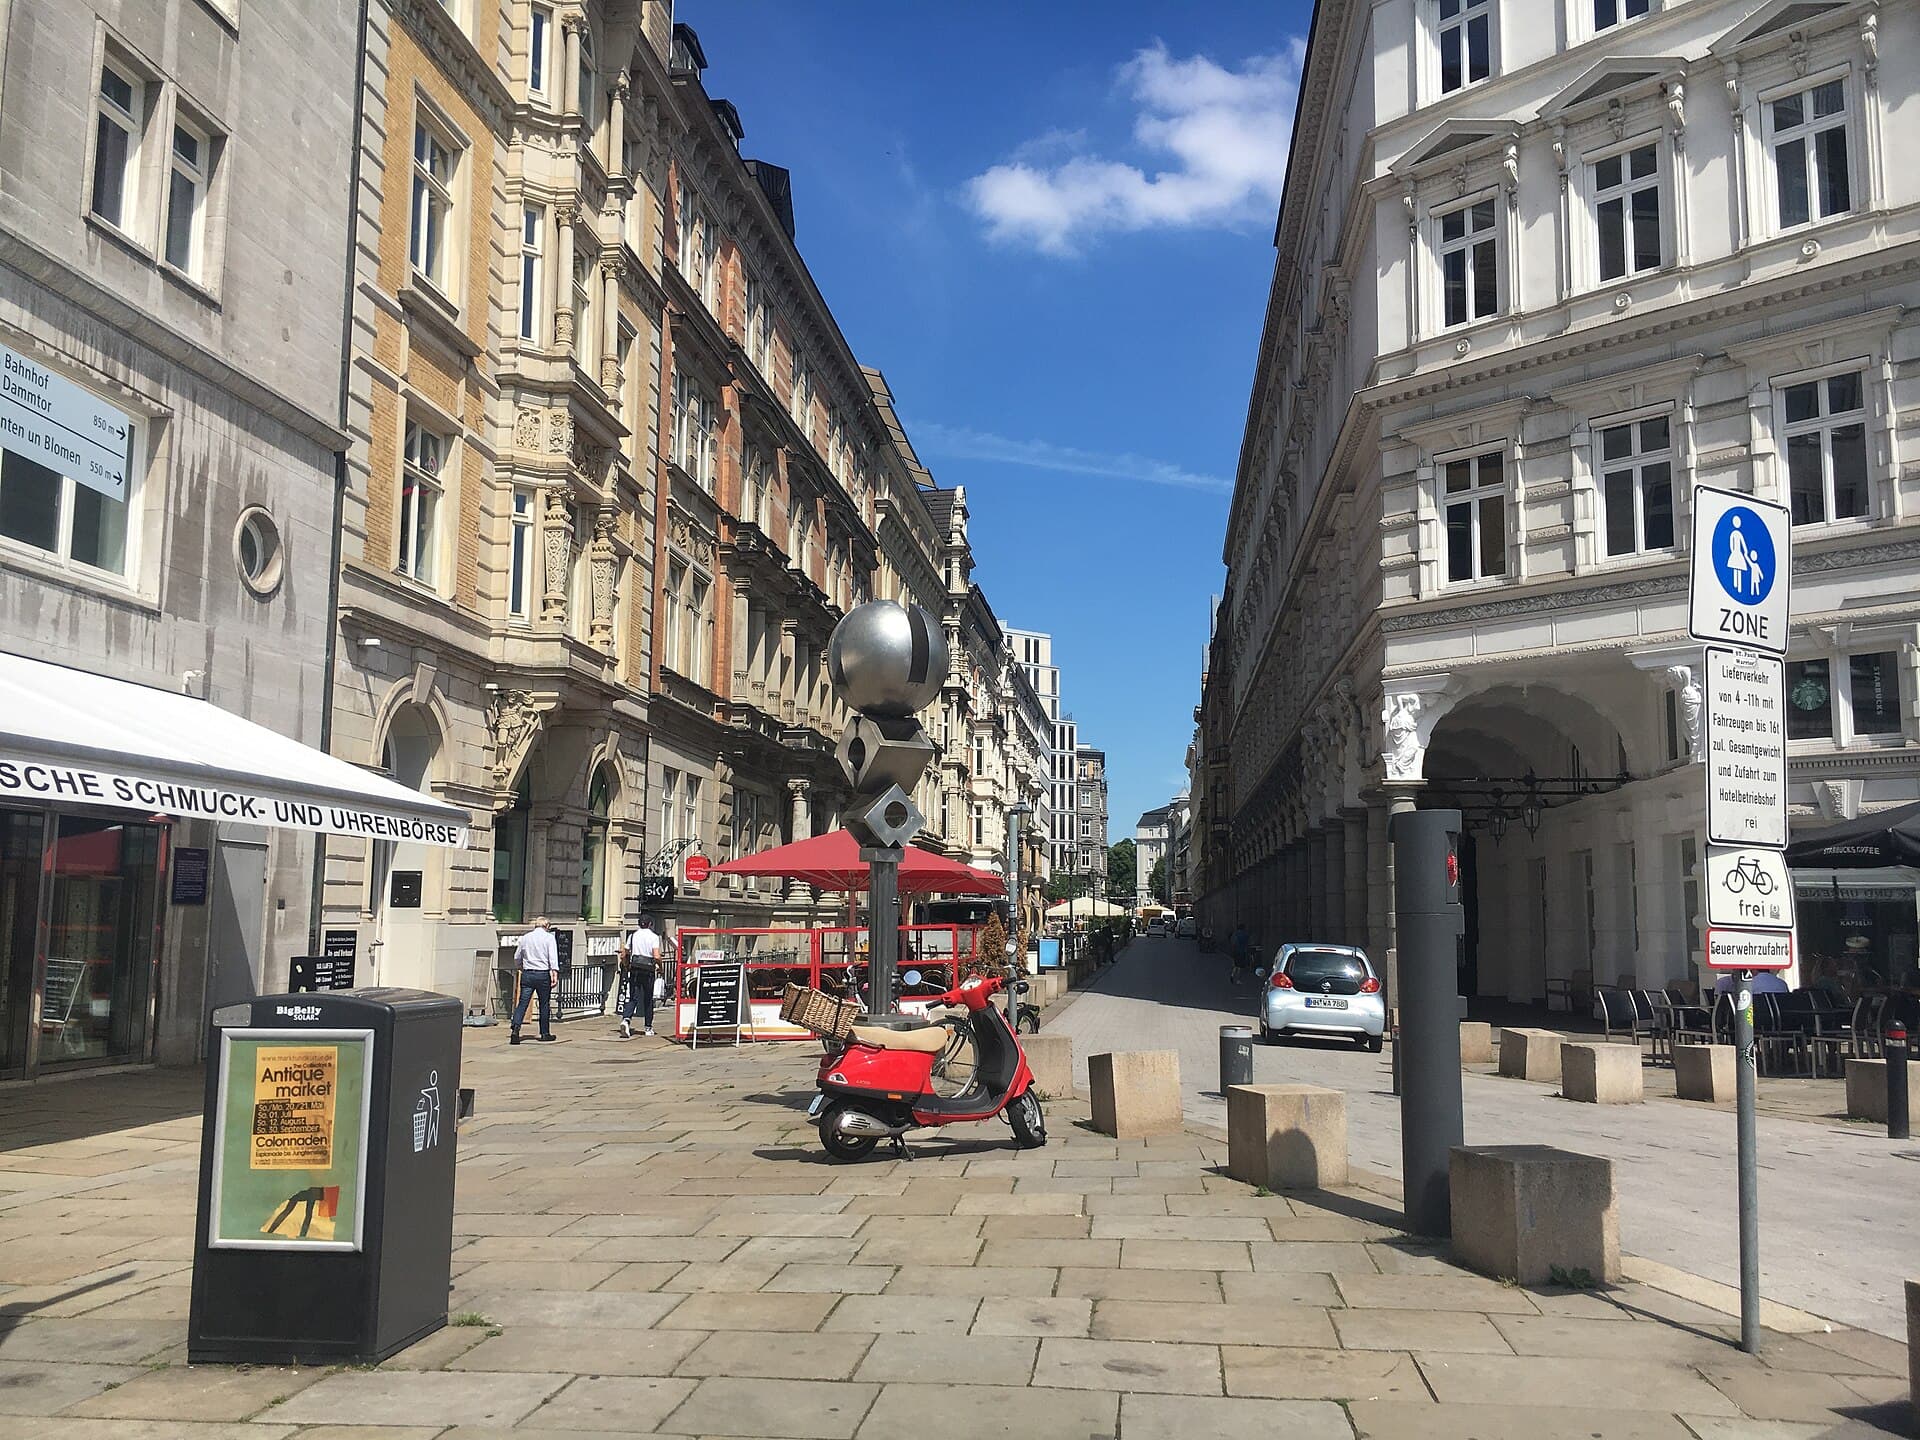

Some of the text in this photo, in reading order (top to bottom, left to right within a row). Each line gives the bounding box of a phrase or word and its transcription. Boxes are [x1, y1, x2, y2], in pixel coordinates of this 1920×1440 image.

[4, 353, 50, 390] Bahnhof
[2, 374, 52, 412] Dammtor
[93, 415, 115, 435] 850 m
[28, 429, 41, 447] un
[44, 435, 82, 466] Blomen
[90, 460, 112, 481] 550 m
[1719, 608, 1769, 639] ZONE
[1721, 665, 1769, 685] Lieferverkehr
[1718, 692, 1732, 704] von
[1735, 690, 1740, 704] 4
[1762, 696, 1774, 710] mit
[1712, 713, 1780, 735] Fahrzeugen bis 16t
[1712, 739, 1781, 759] zul. Gesamtgewicht
[1718, 765, 1777, 782] und Zufahrt zum
[0, 762, 458, 844] SCHE SCHMUCK- UND UHRENBÖRSE
[1719, 788, 1777, 806] Hotelbetriebshof
[1745, 816, 1758, 829] rei
[644, 882, 669, 899] sky
[1739, 899, 1765, 918] frei
[1711, 941, 1789, 956] Feuerwehrzufahrt
[276, 1006, 322, 1017] BigBelly
[261, 1066, 325, 1085] Antique
[275, 1081, 332, 1098] market
[256, 1126, 267, 1134] So.
[280, 1125, 319, 1134] September
[280, 1118, 305, 1127] August
[255, 1134, 328, 1148] Colonnaden
[255, 1150, 283, 1158] Esplanade
